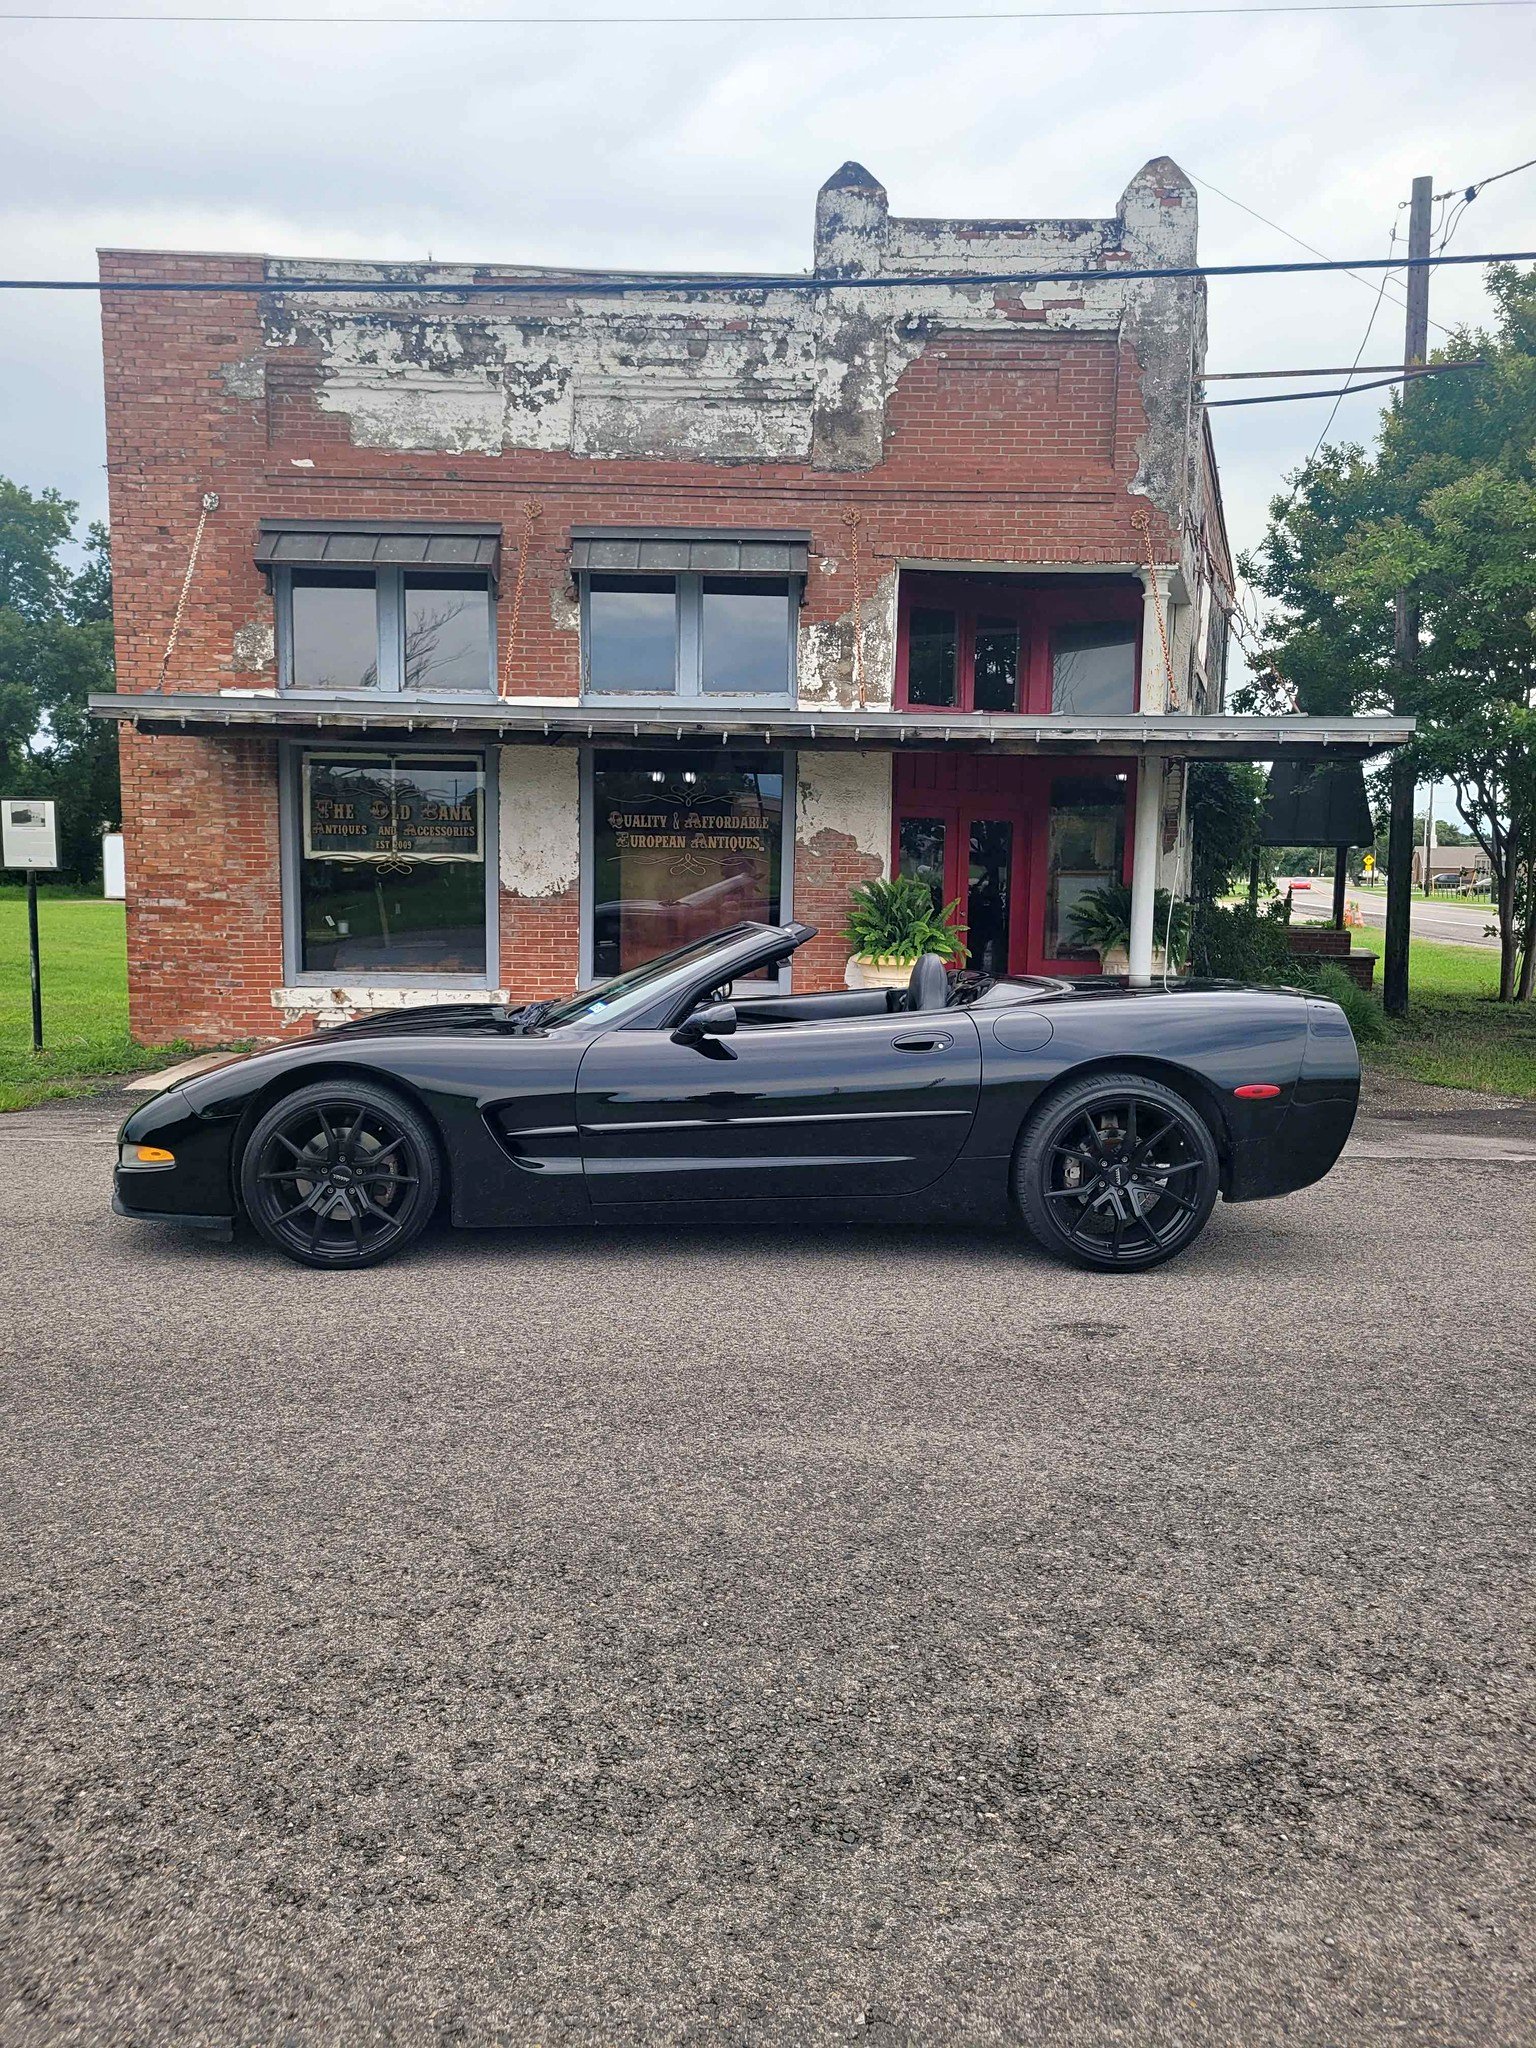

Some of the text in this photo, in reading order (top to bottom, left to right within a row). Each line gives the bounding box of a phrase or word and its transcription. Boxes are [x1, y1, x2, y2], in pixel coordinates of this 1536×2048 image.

[315, 799, 472, 821] THE OLD BANK
[607, 811, 769, 829] QUALITY & AFFORDABLE
[313, 822, 475, 837] ANTIQUES AND ACCESSORIES
[376, 841, 390, 849] EST
[615, 831, 687, 848] EUROPEAN
